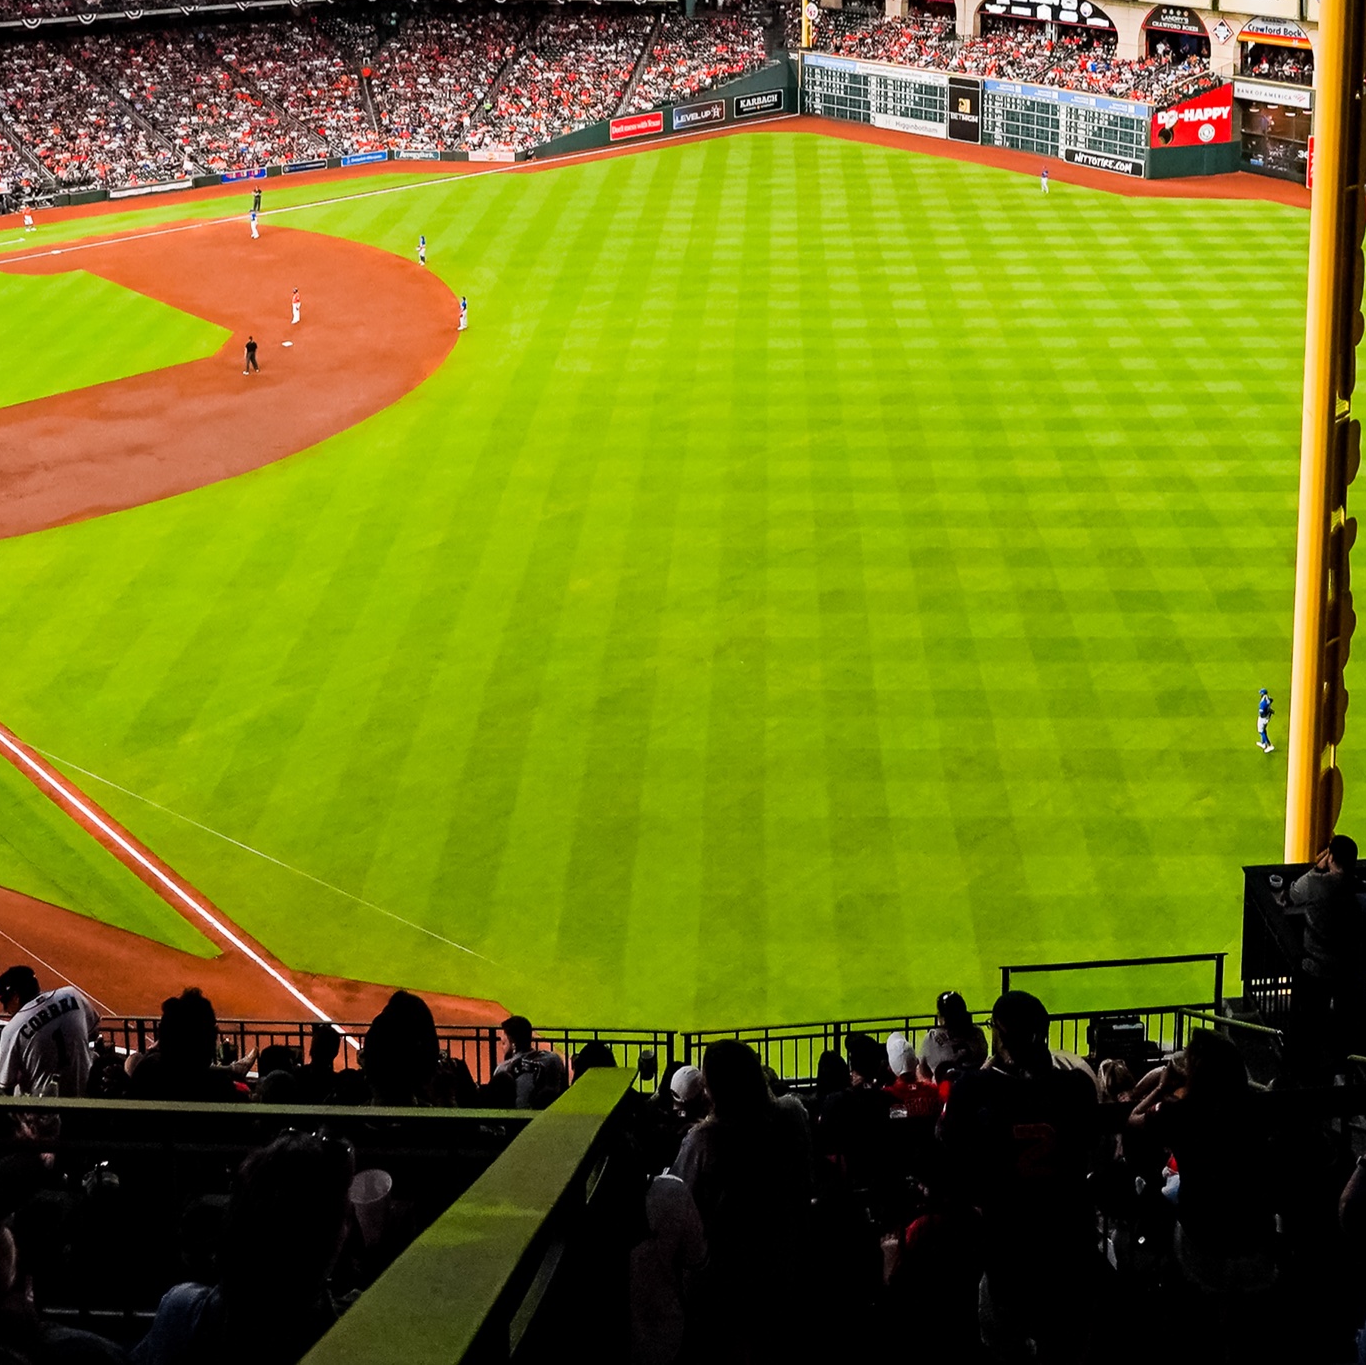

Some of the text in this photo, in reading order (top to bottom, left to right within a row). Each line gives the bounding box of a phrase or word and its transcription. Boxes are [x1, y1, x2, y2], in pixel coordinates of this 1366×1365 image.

[1247, 23, 1302, 38] Crawford Bock
[739, 94, 778, 108] KARBACH
[1237, 87, 1292, 102] BANK OF AMERICA
[675, 110, 711, 124] LEVEL UP
[950, 114, 978, 124] BETMGM
[895, 121, 938, 135] Higginbotham
[1074, 152, 1133, 173] NITTOTIRE.COM
